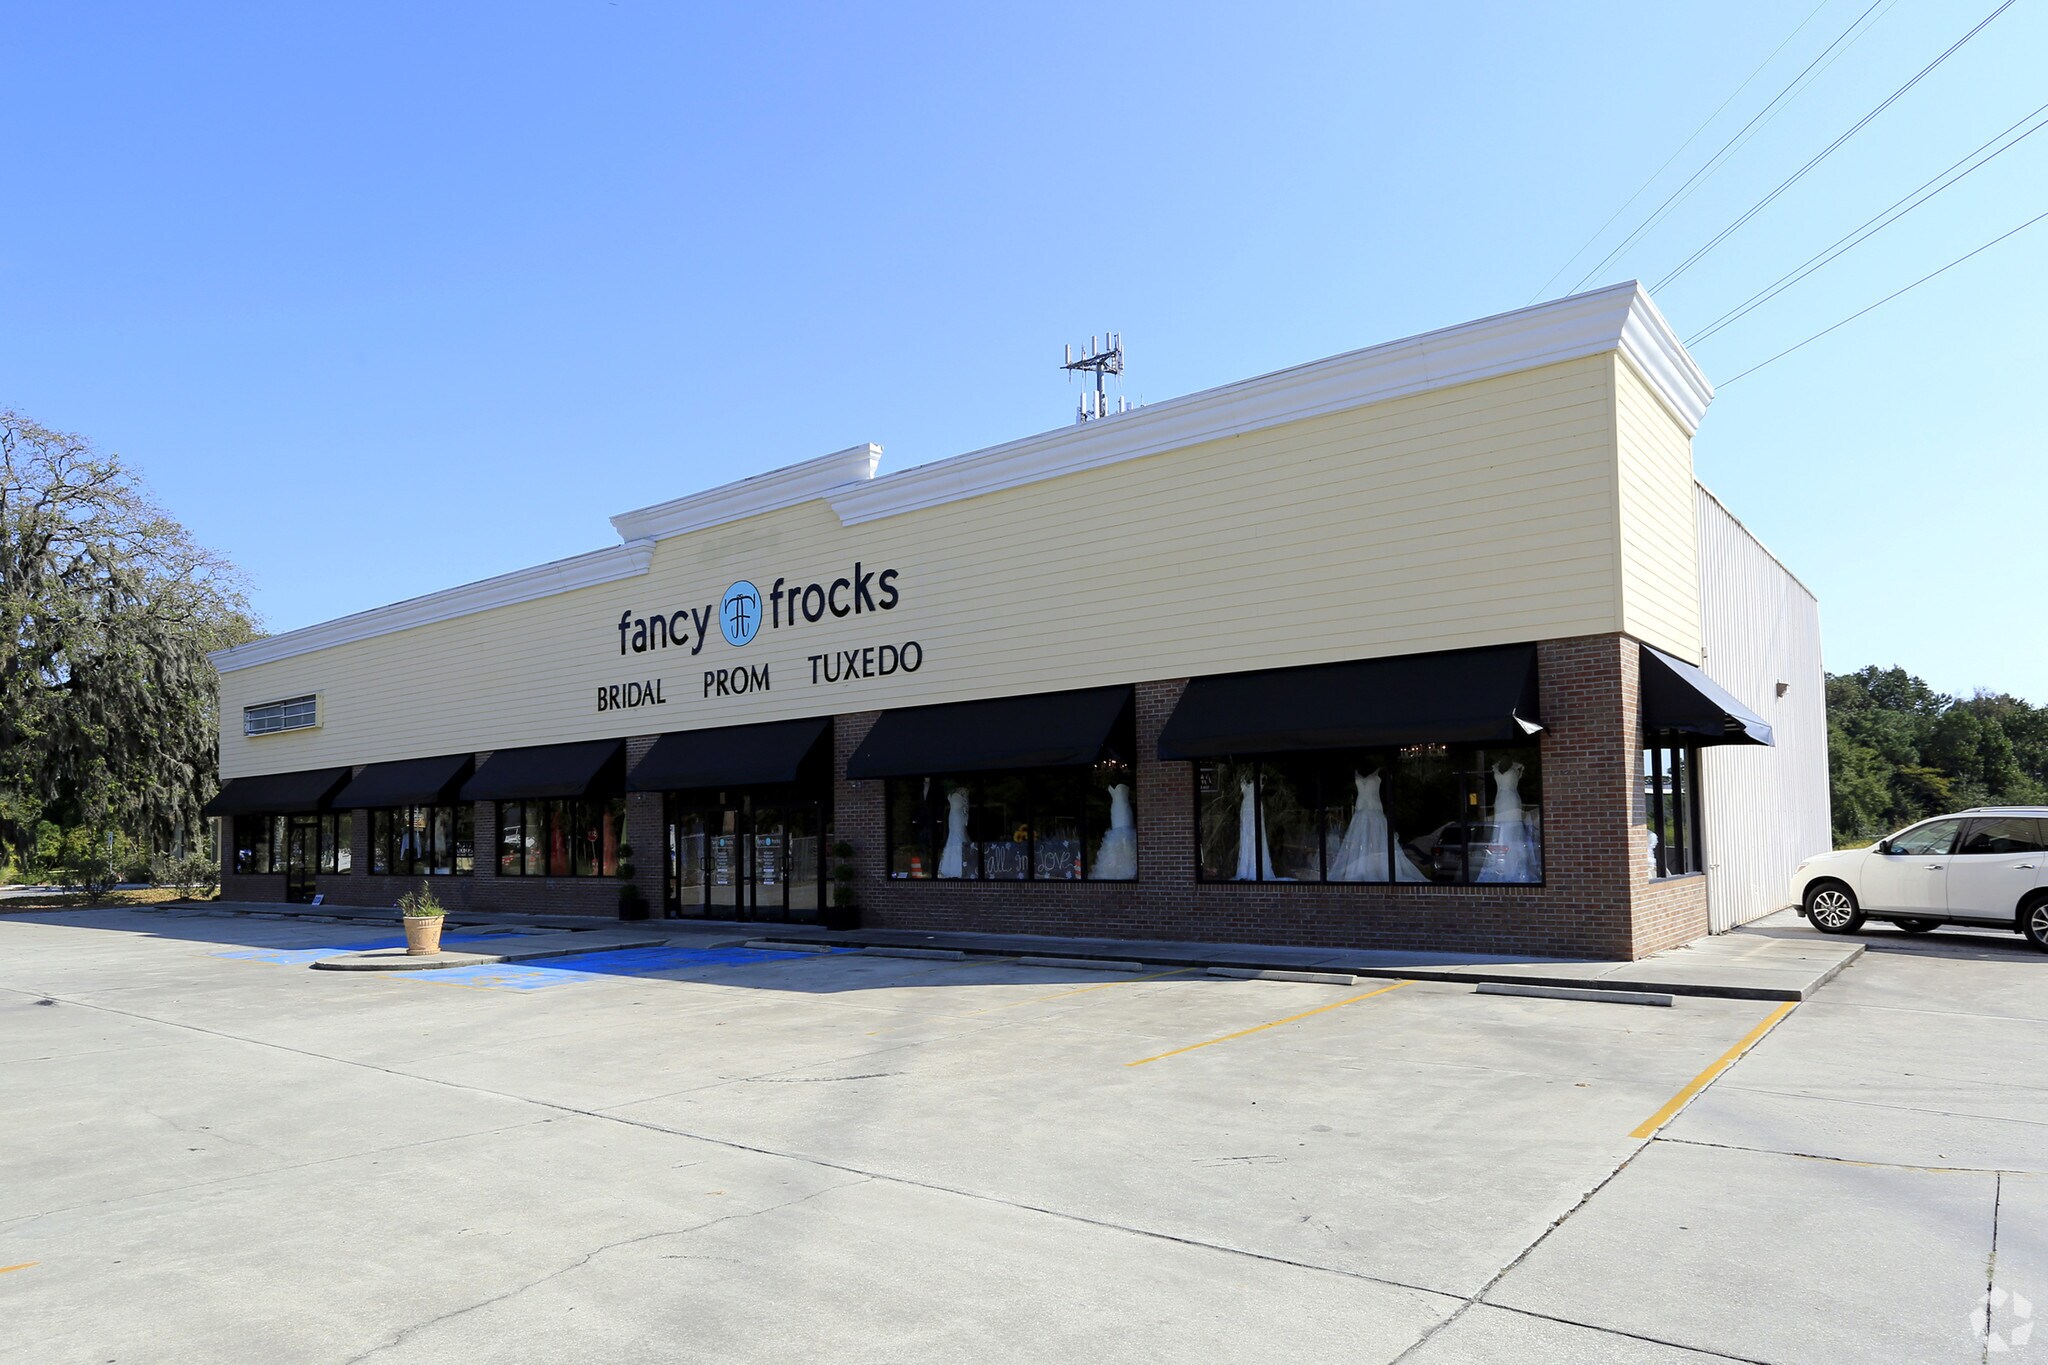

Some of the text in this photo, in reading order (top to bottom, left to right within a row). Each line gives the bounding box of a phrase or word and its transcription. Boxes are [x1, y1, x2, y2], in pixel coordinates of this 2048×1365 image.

[769, 562, 899, 629] frocks
[618, 604, 712, 656] fancy
[597, 640, 923, 712] BRIDAL PROM TUXEDO
